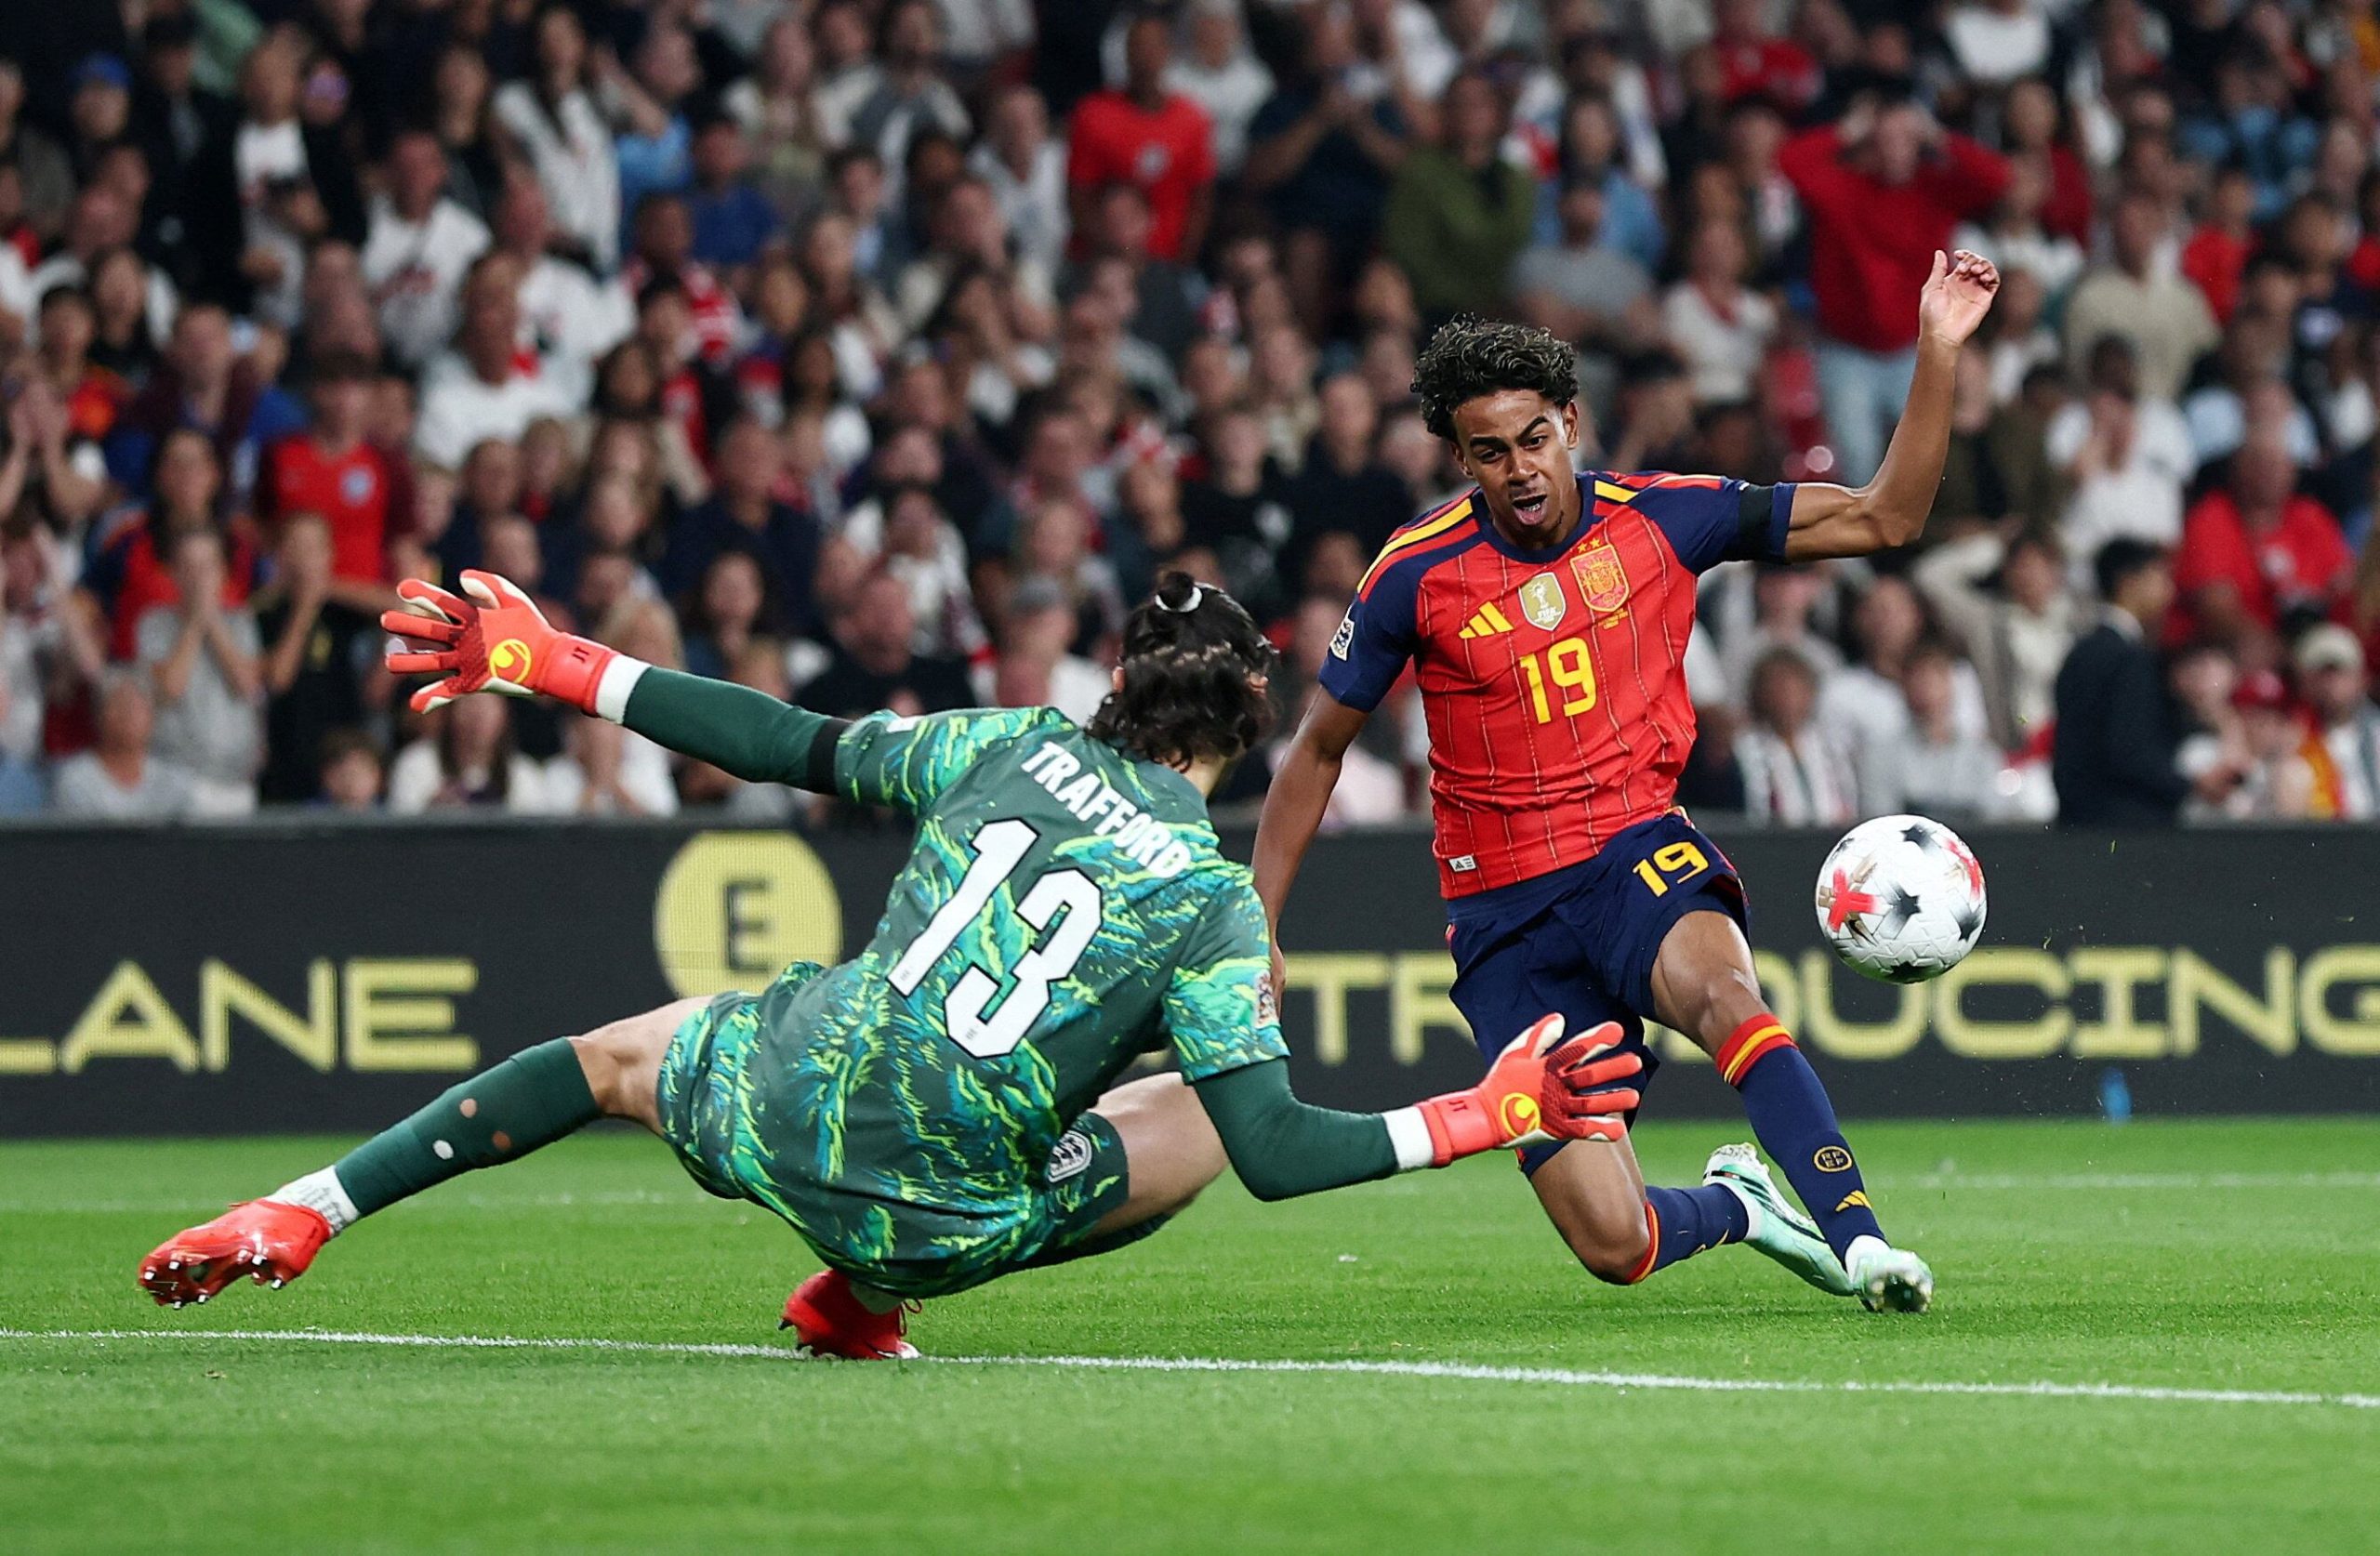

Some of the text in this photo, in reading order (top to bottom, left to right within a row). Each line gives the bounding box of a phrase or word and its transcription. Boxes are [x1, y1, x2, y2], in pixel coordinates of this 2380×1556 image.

[1520, 638, 1597, 724] 19
[1021, 741, 1192, 878] TRAFFORD
[1632, 841, 1709, 898] 19
[886, 817, 1103, 1060] 13
